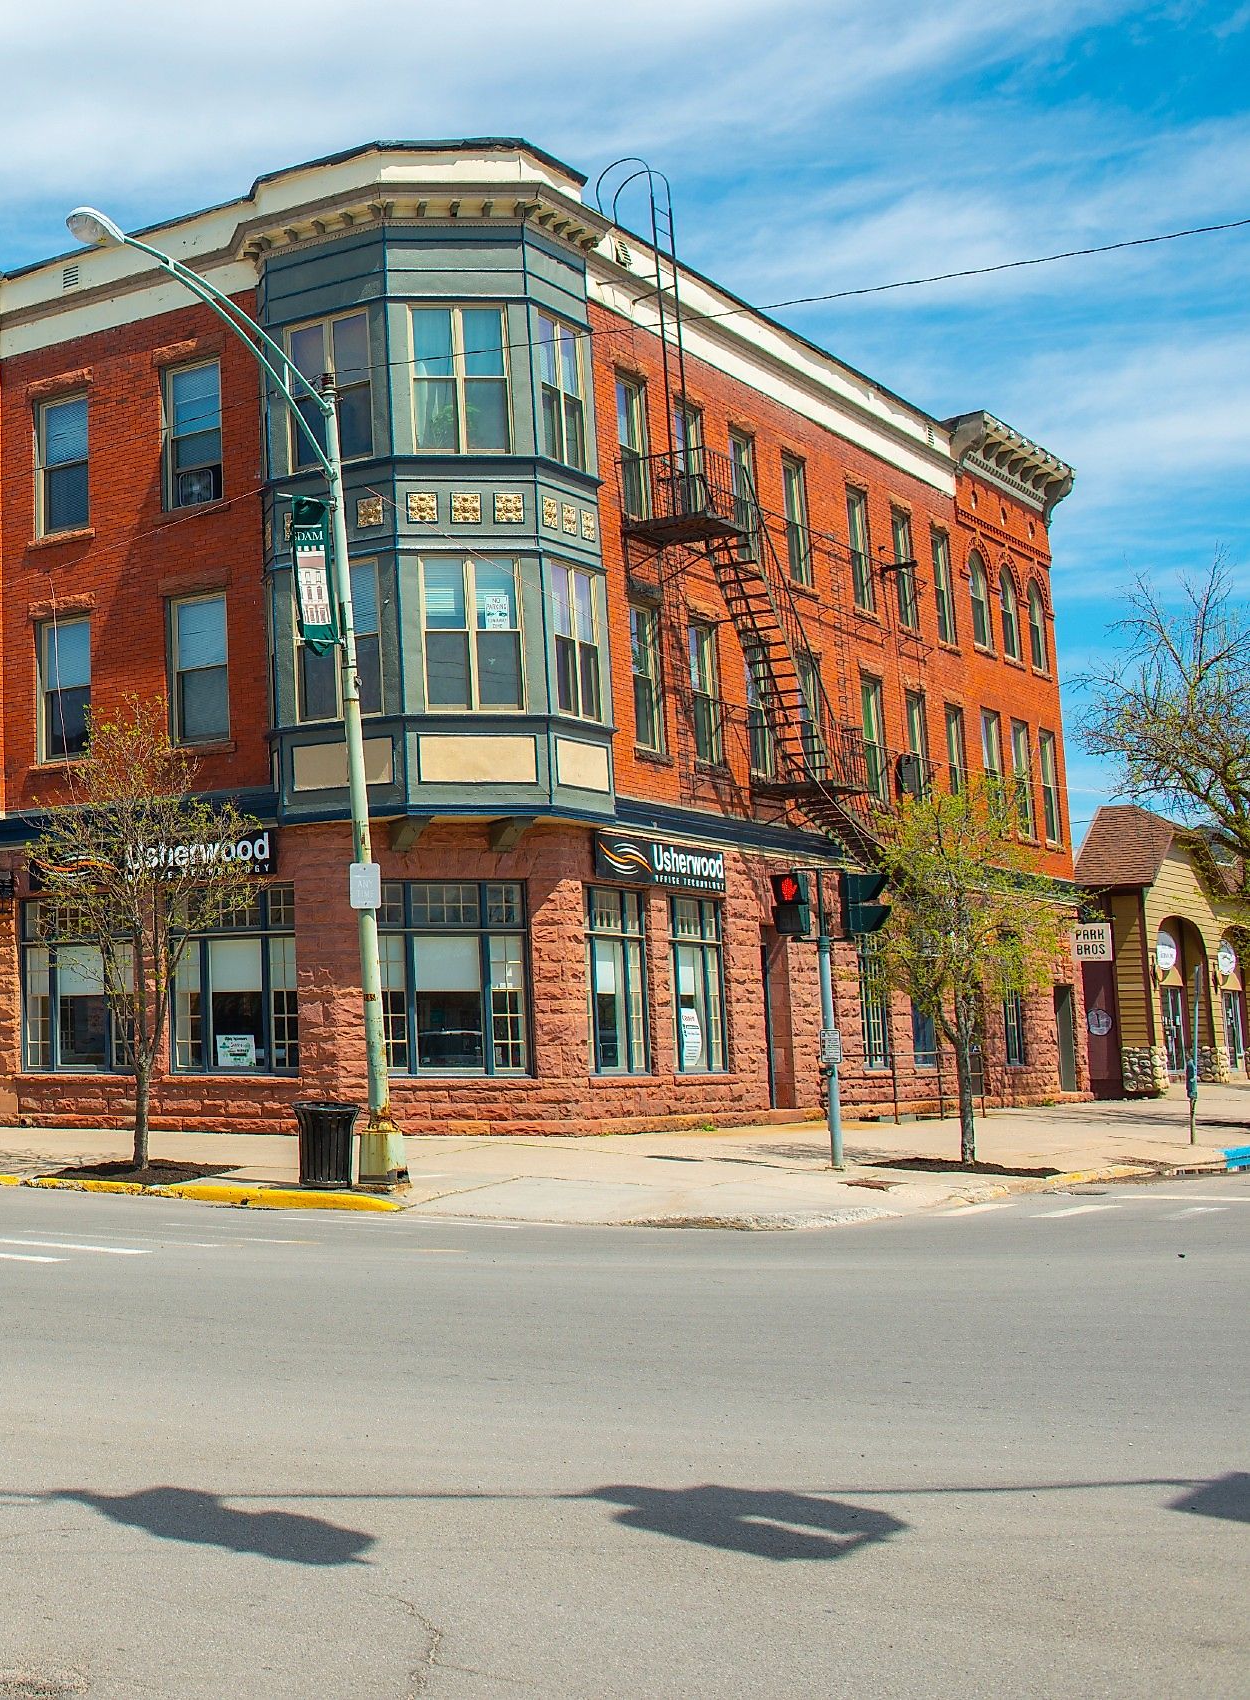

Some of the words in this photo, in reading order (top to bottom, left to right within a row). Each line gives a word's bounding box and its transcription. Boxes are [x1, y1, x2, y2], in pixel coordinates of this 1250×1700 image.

[652, 844, 725, 879] Usherwood
[1076, 929, 1104, 940] PARK
[1076, 944, 1105, 956] BROS
